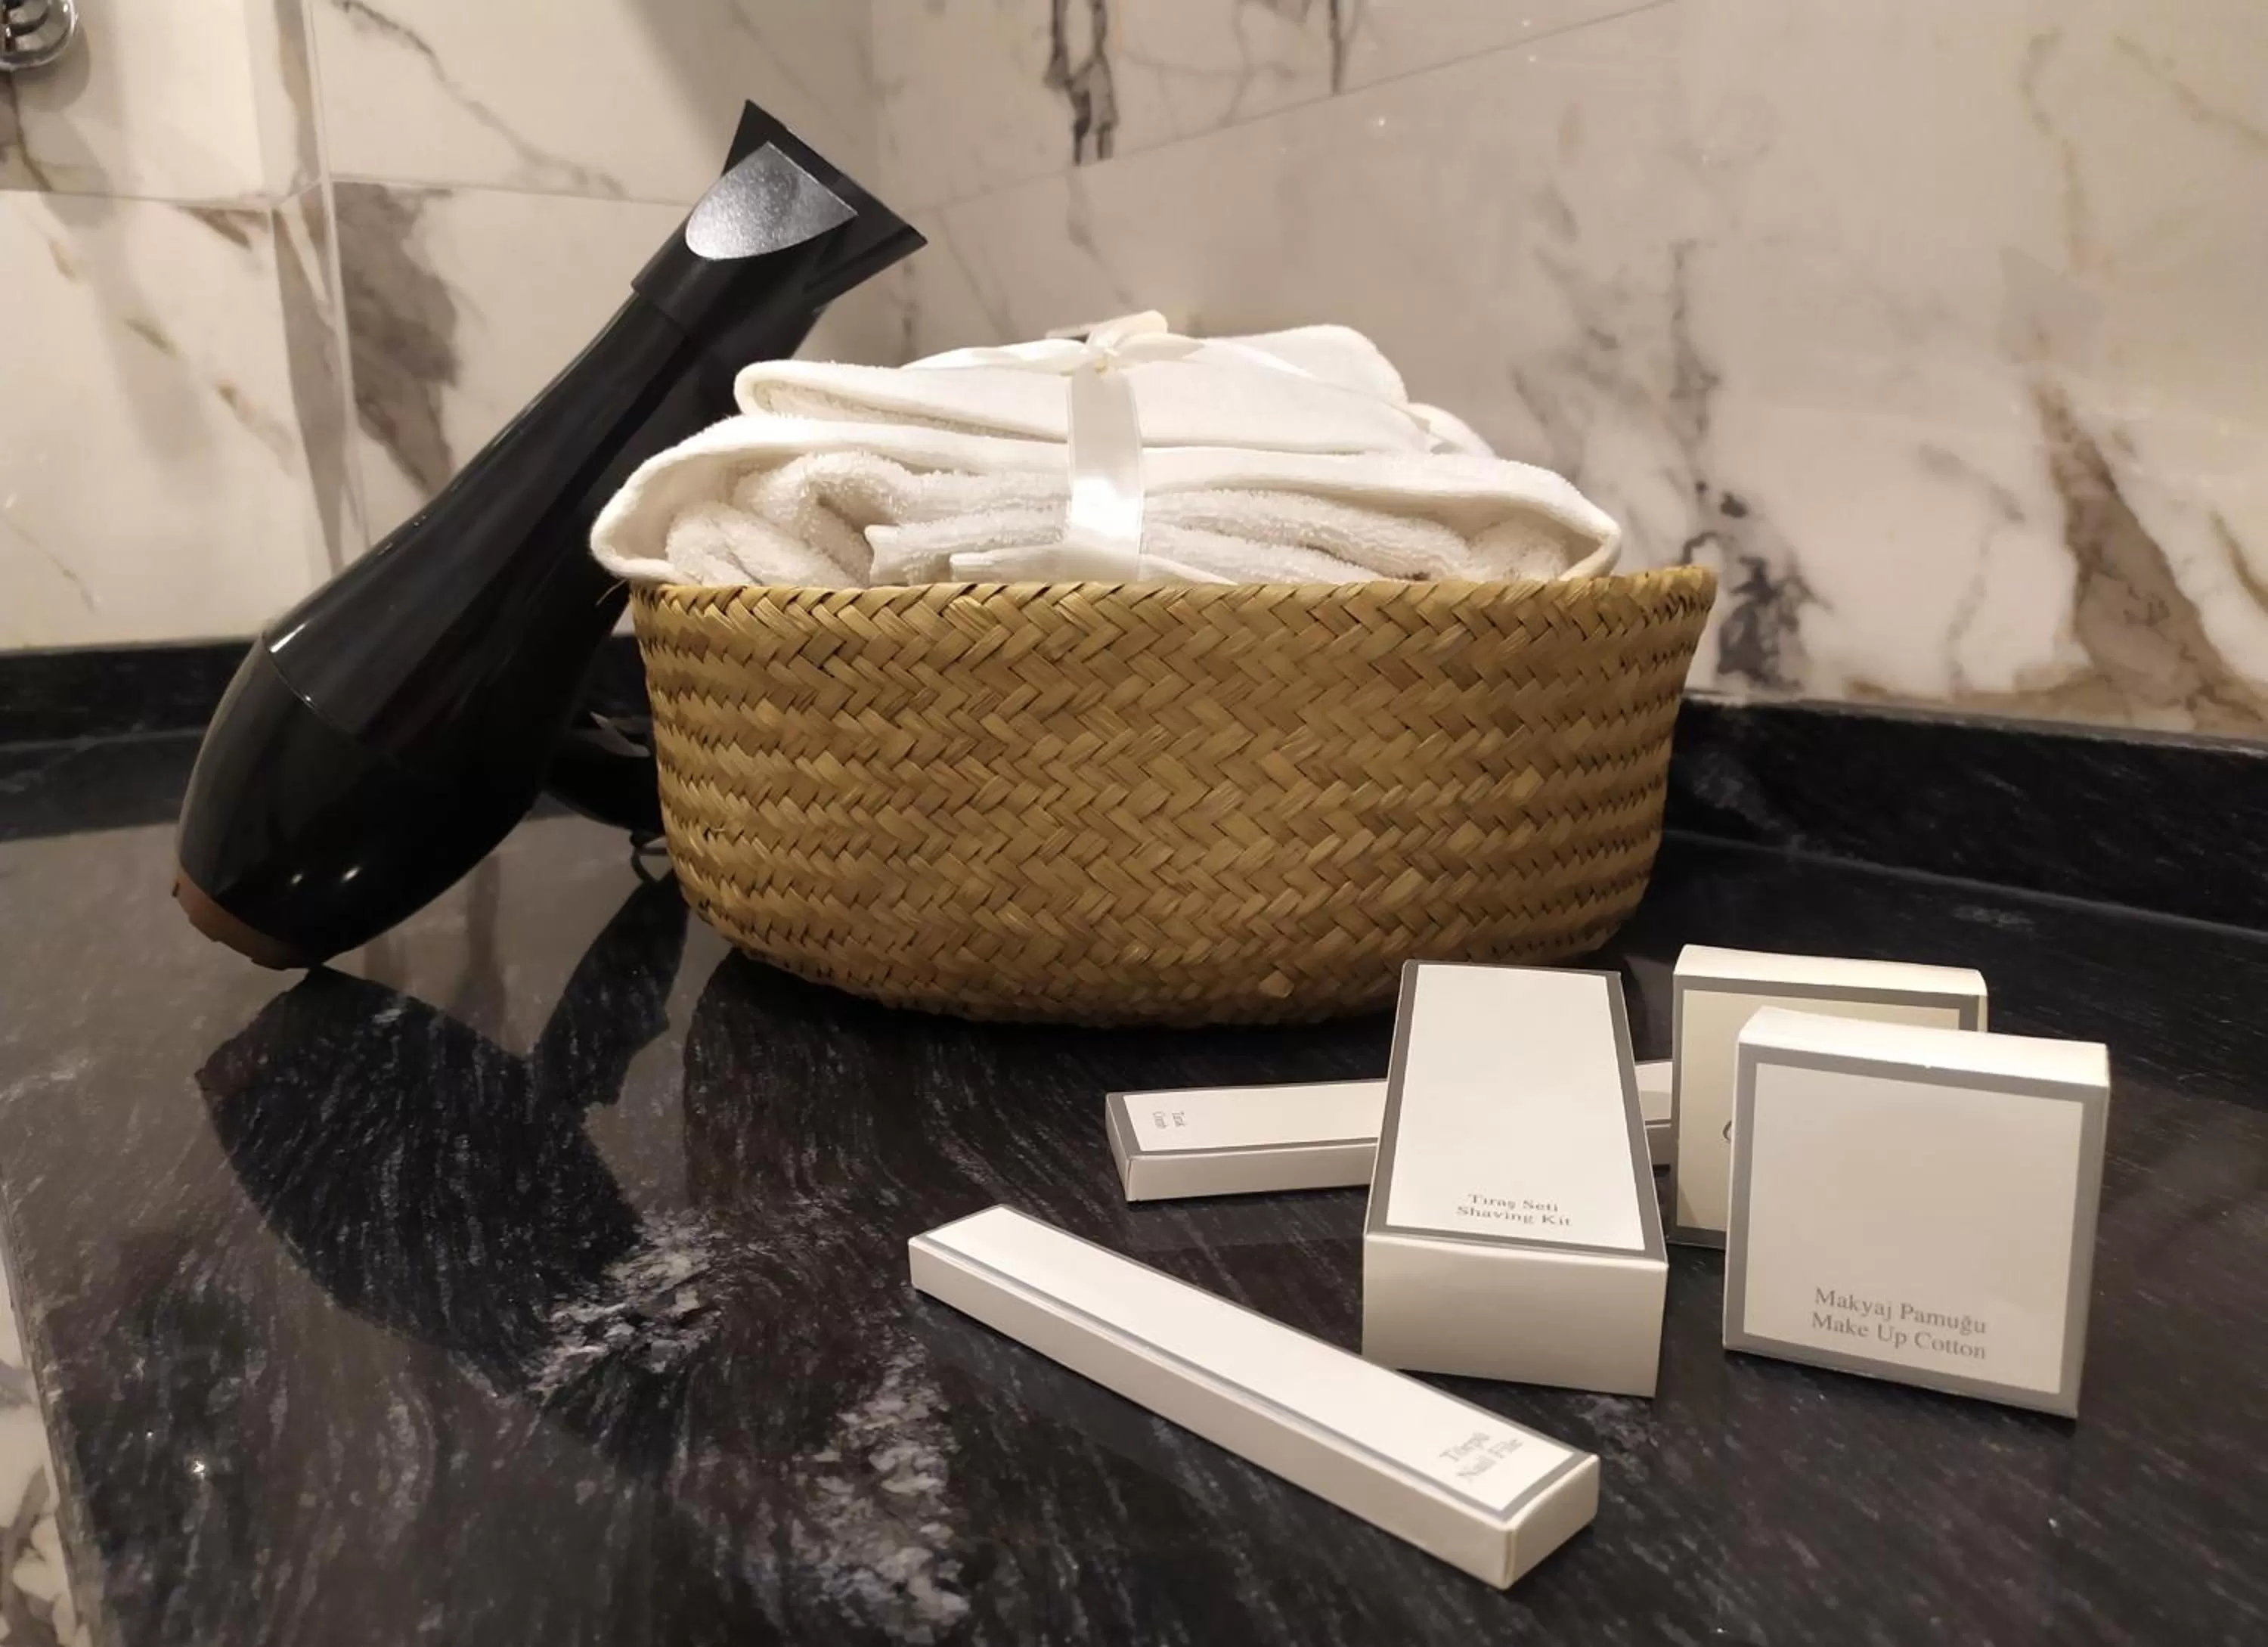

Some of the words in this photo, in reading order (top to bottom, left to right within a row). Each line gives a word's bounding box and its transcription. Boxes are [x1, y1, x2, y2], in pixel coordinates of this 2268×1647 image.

[1457, 1205, 1534, 1224] Shaving
[1541, 1213, 1570, 1226] Kit
[1811, 1311, 1870, 1338] Make
[1877, 1323, 1907, 1349] Up
[1914, 1330, 1986, 1360] Cotton
[1814, 1287, 1892, 1321] Makyaj
[1900, 1301, 1986, 1336] Pamuğu
